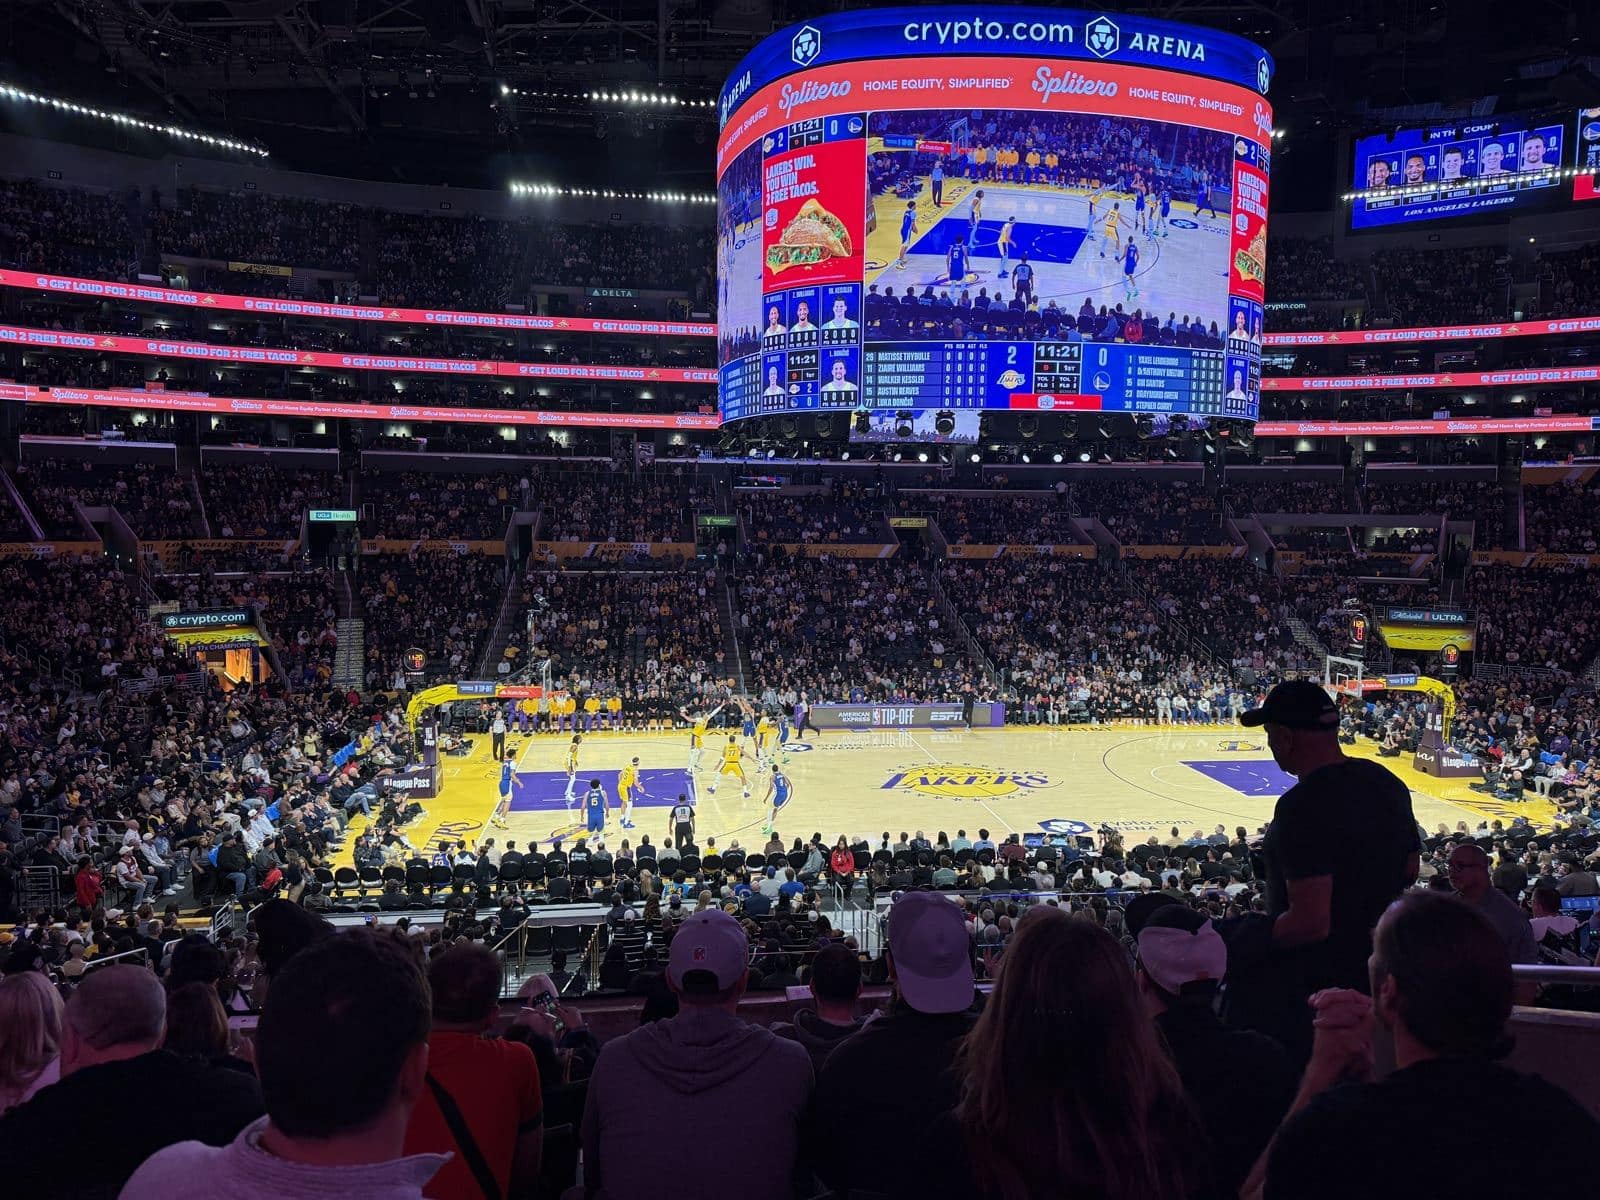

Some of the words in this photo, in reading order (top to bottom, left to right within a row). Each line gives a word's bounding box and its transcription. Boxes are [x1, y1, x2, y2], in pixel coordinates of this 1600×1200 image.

[904, 17, 1073, 44] crypto.com
[1129, 32, 1205, 62] ARENA
[727, 70, 751, 112] ARENA
[863, 80, 898, 91] HOME
[901, 78, 945, 91] EQUITY,
[948, 77, 1010, 89] SIMPLIFIED
[1031, 66, 1119, 104] Splitero
[778, 80, 851, 119] Splitero
[1129, 87, 1159, 101] HOME
[791, 119, 819, 133] 11:21
[831, 119, 838, 135] 0
[1464, 123, 1499, 134] COUR
[778, 133, 783, 147] 2
[766, 159, 793, 179] LAKERS
[766, 177, 779, 192] YOU
[781, 171, 798, 188] WIN
[771, 188, 789, 204] FREE
[1425, 202, 1470, 214] ANGELES
[1471, 196, 1515, 207] LAKERS
[50, 279, 72, 290] GET
[72, 281, 103, 293] LOUD
[105, 285, 127, 297] FOR
[129, 288, 136, 297] 2
[137, 289, 163, 300] FREE
[165, 292, 197, 304] TACOS
[602, 289, 632, 297] DELTA
[255, 301, 273, 310] GET
[275, 302, 301, 313] LOUD
[303, 304, 322, 314] FOR
[331, 307, 354, 317] FREE
[356, 309, 384, 319] TACOS
[435, 313, 452, 322] GET
[453, 314, 477, 324] LOUD
[479, 316, 497, 325] FOR
[505, 317, 526, 326] FREE
[527, 319, 554, 328] TACOS
[1559, 321, 1580, 330] GET
[19, 332, 27, 341] 2
[28, 333, 57, 344] FREE
[59, 335, 96, 346] TACOS
[1275, 335, 1296, 344] FREE
[1297, 334, 1324, 343] TACOS
[1392, 331, 1418, 340] LOUD
[1418, 330, 1437, 339] FOR
[1446, 328, 1470, 337] FREE
[1471, 327, 1502, 336] TACOS
[159, 344, 180, 354] GET
[180, 346, 208, 356] LOUD
[210, 348, 230, 358] FOR
[240, 350, 265, 360] FREE
[267, 352, 297, 361] TACOS
[1007, 346, 1017, 364] 2
[1037, 345, 1079, 358] 11:21
[1098, 347, 1108, 366] 0
[353, 358, 371, 367] GET
[371, 359, 397, 368] LOUD
[398, 360, 417, 368] FOR
[425, 362, 448, 370] FREE
[449, 362, 477, 371] TACOS
[789, 355, 816, 365] 11:21
[529, 367, 546, 375] GET
[547, 367, 570, 376] LOUD
[571, 368, 589, 377] FOR
[596, 369, 618, 377] FREE
[618, 370, 645, 378] TACOS
[1512, 373, 1538, 381] LOUD
[1540, 372, 1561, 380] FOR
[1571, 370, 1598, 378] FREE
[1312, 380, 1329, 388] GET
[1329, 379, 1354, 388] LOUD
[1355, 379, 1373, 387] FOR
[1382, 378, 1405, 386] FREE
[1405, 377, 1435, 385] TACOS
[179, 613, 246, 625] crypto.com
[881, 708, 915, 725] TIP-OFF
[930, 711, 963, 721] ESPN
[413, 777, 430, 788] Pass
[880, 772, 1050, 789] LAKERS
